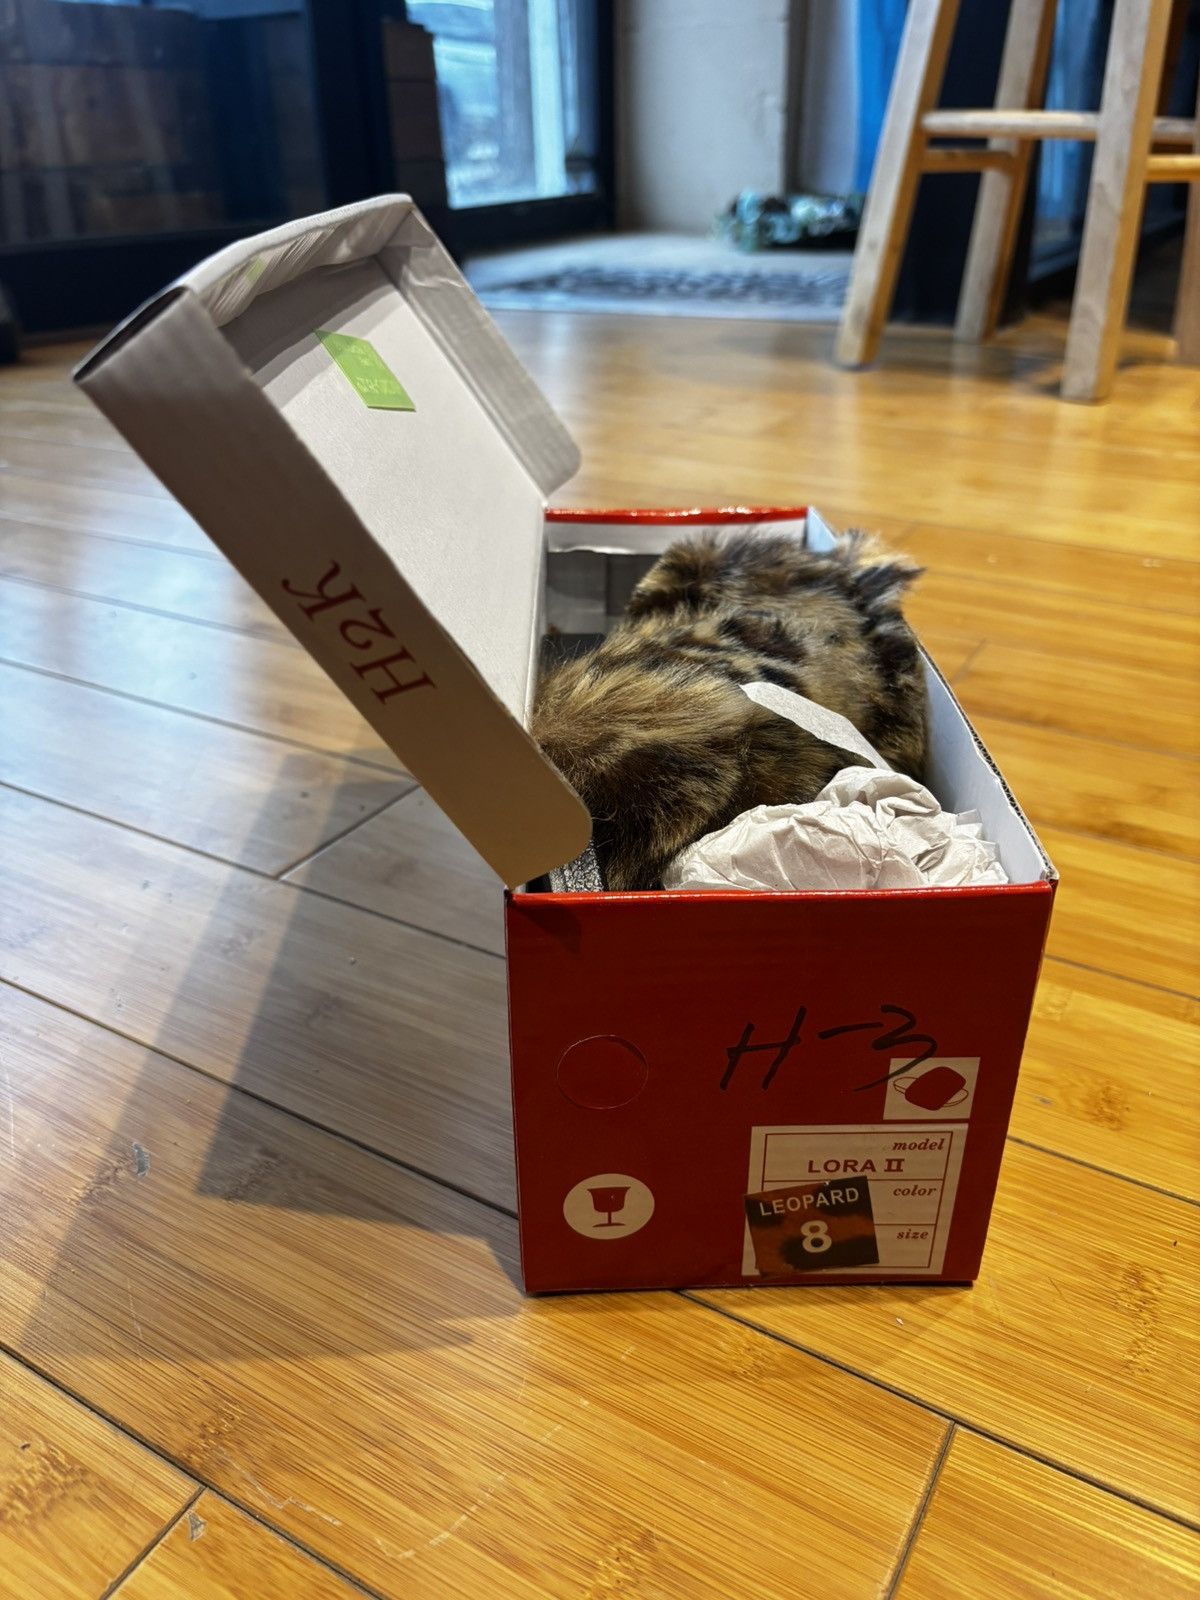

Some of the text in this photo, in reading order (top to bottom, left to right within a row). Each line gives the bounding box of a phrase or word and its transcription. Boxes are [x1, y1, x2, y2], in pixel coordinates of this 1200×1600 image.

[281, 558, 438, 706] H2K
[891, 1137, 946, 1151] model
[807, 1157, 906, 1174] LORA II
[892, 1184, 937, 1197] color
[759, 1186, 860, 1217] LEOPARD
[800, 1219, 833, 1254] 8
[896, 1227, 929, 1241] size
